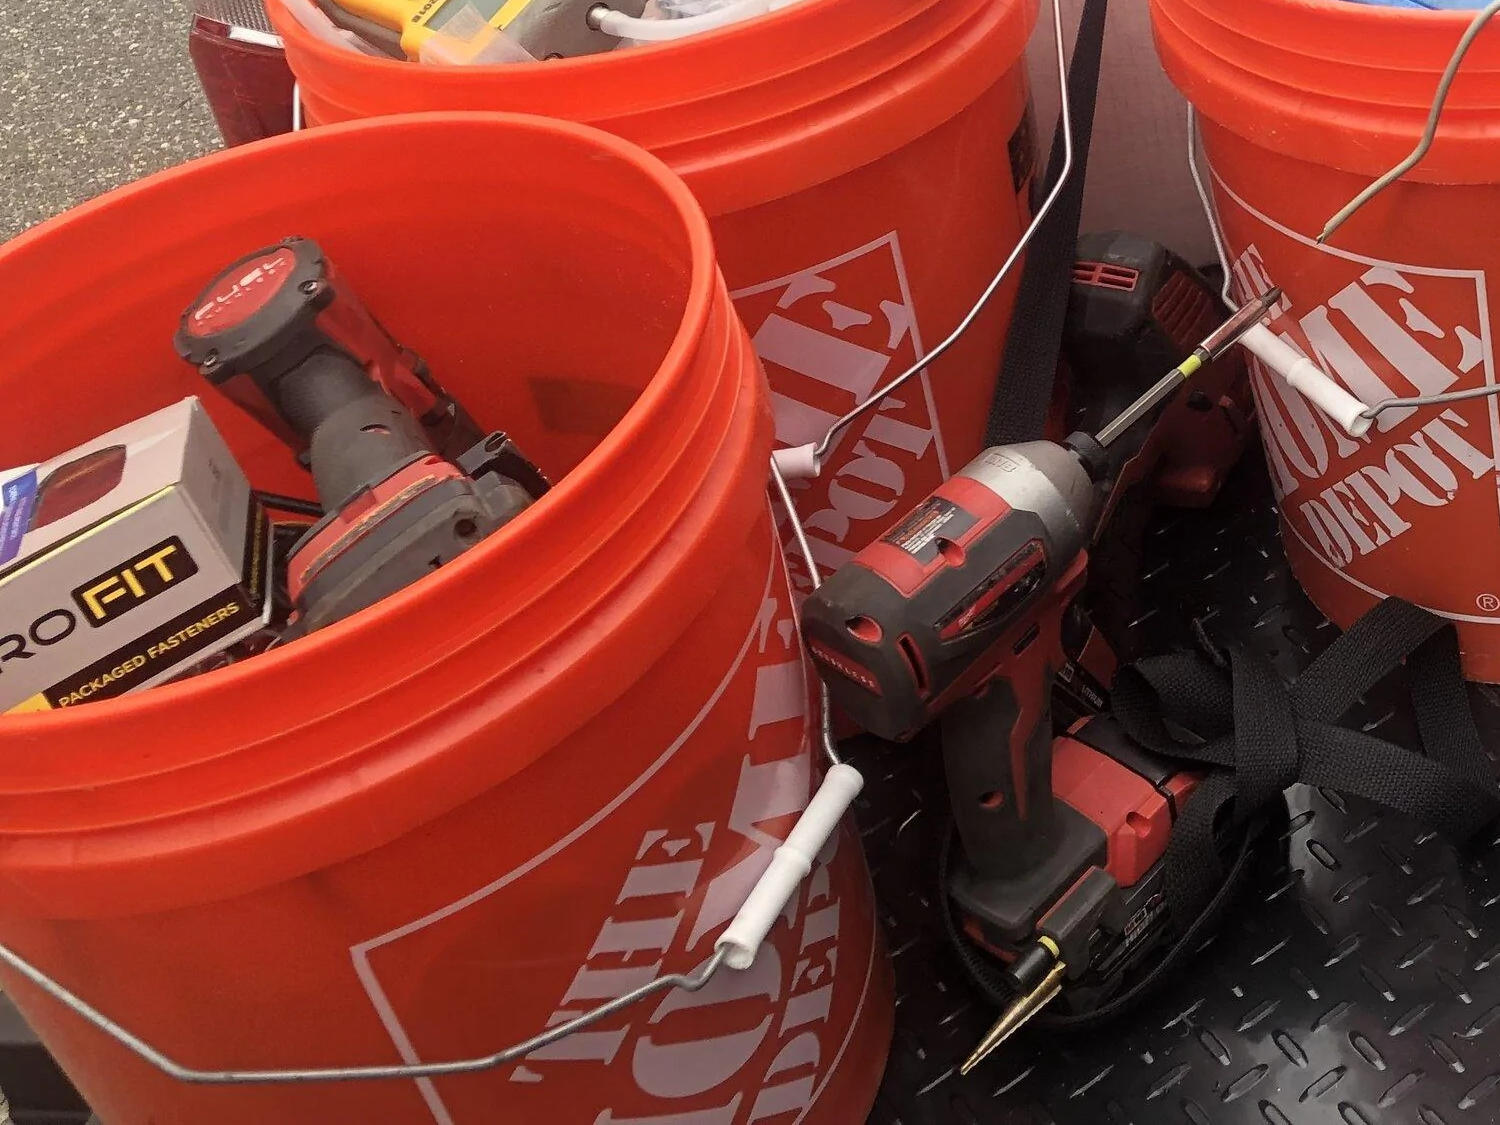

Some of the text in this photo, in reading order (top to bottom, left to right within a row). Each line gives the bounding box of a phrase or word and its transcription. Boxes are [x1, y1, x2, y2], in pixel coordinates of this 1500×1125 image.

[1299, 407, 1496, 568] DEPOT
[58, 601, 241, 708] PACKAGED FASTENERS
